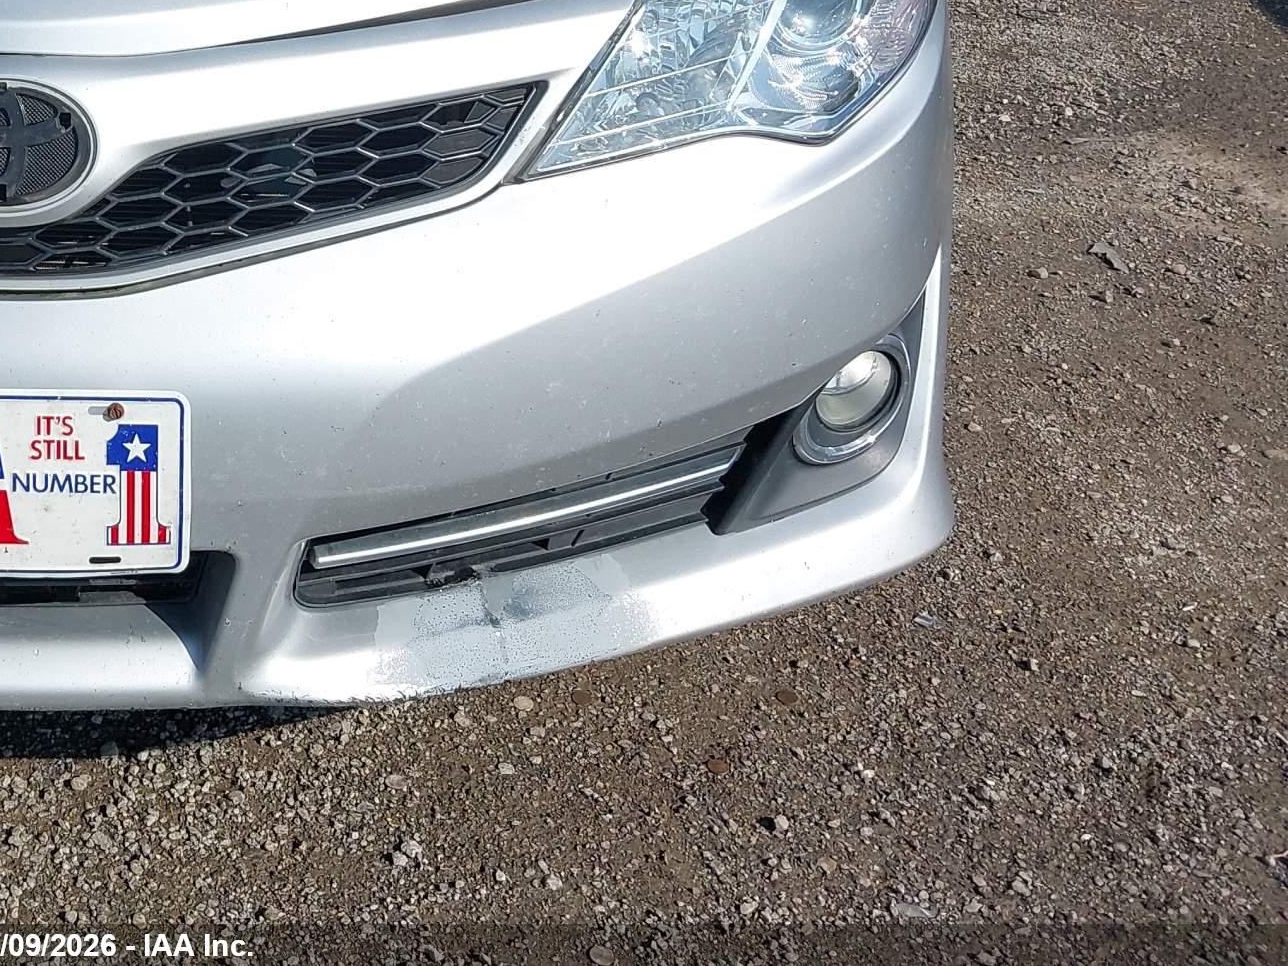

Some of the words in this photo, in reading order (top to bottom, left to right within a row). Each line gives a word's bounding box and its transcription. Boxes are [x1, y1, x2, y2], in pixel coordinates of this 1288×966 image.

[36, 415, 74, 436] IT'S
[29, 439, 85, 461] STILL
[11, 472, 117, 495] NUMBER
[106, 424, 171, 546] 1
